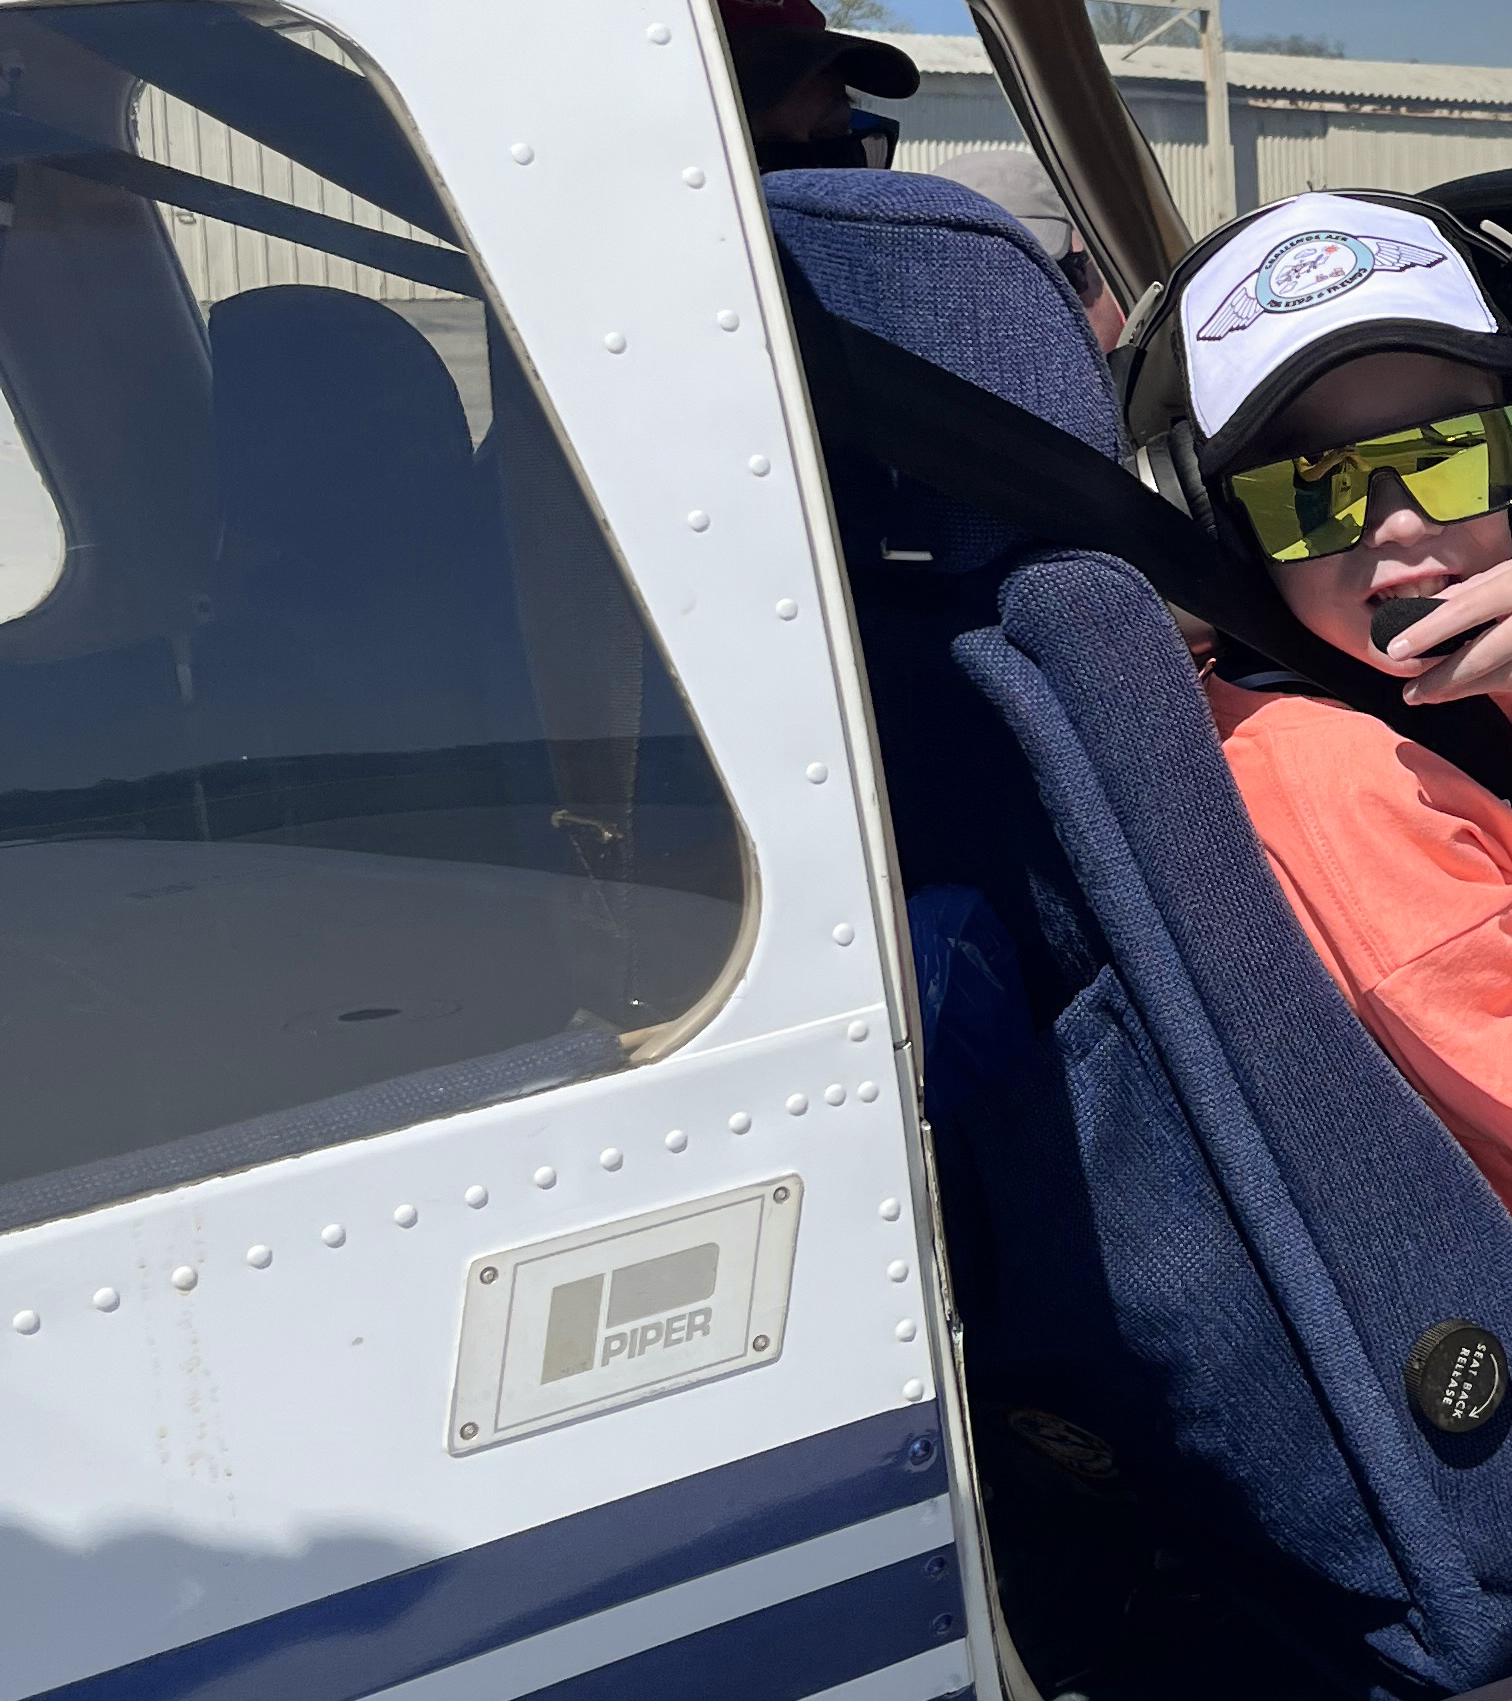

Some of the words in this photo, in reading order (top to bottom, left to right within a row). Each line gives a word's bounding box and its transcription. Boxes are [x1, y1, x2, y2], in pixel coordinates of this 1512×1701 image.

[601, 1306, 713, 1367] PIPER
[1468, 1343, 1487, 1377] SEAT
[1442, 1347, 1471, 1405] RELEASE
[1452, 1381, 1473, 1419] BACK
